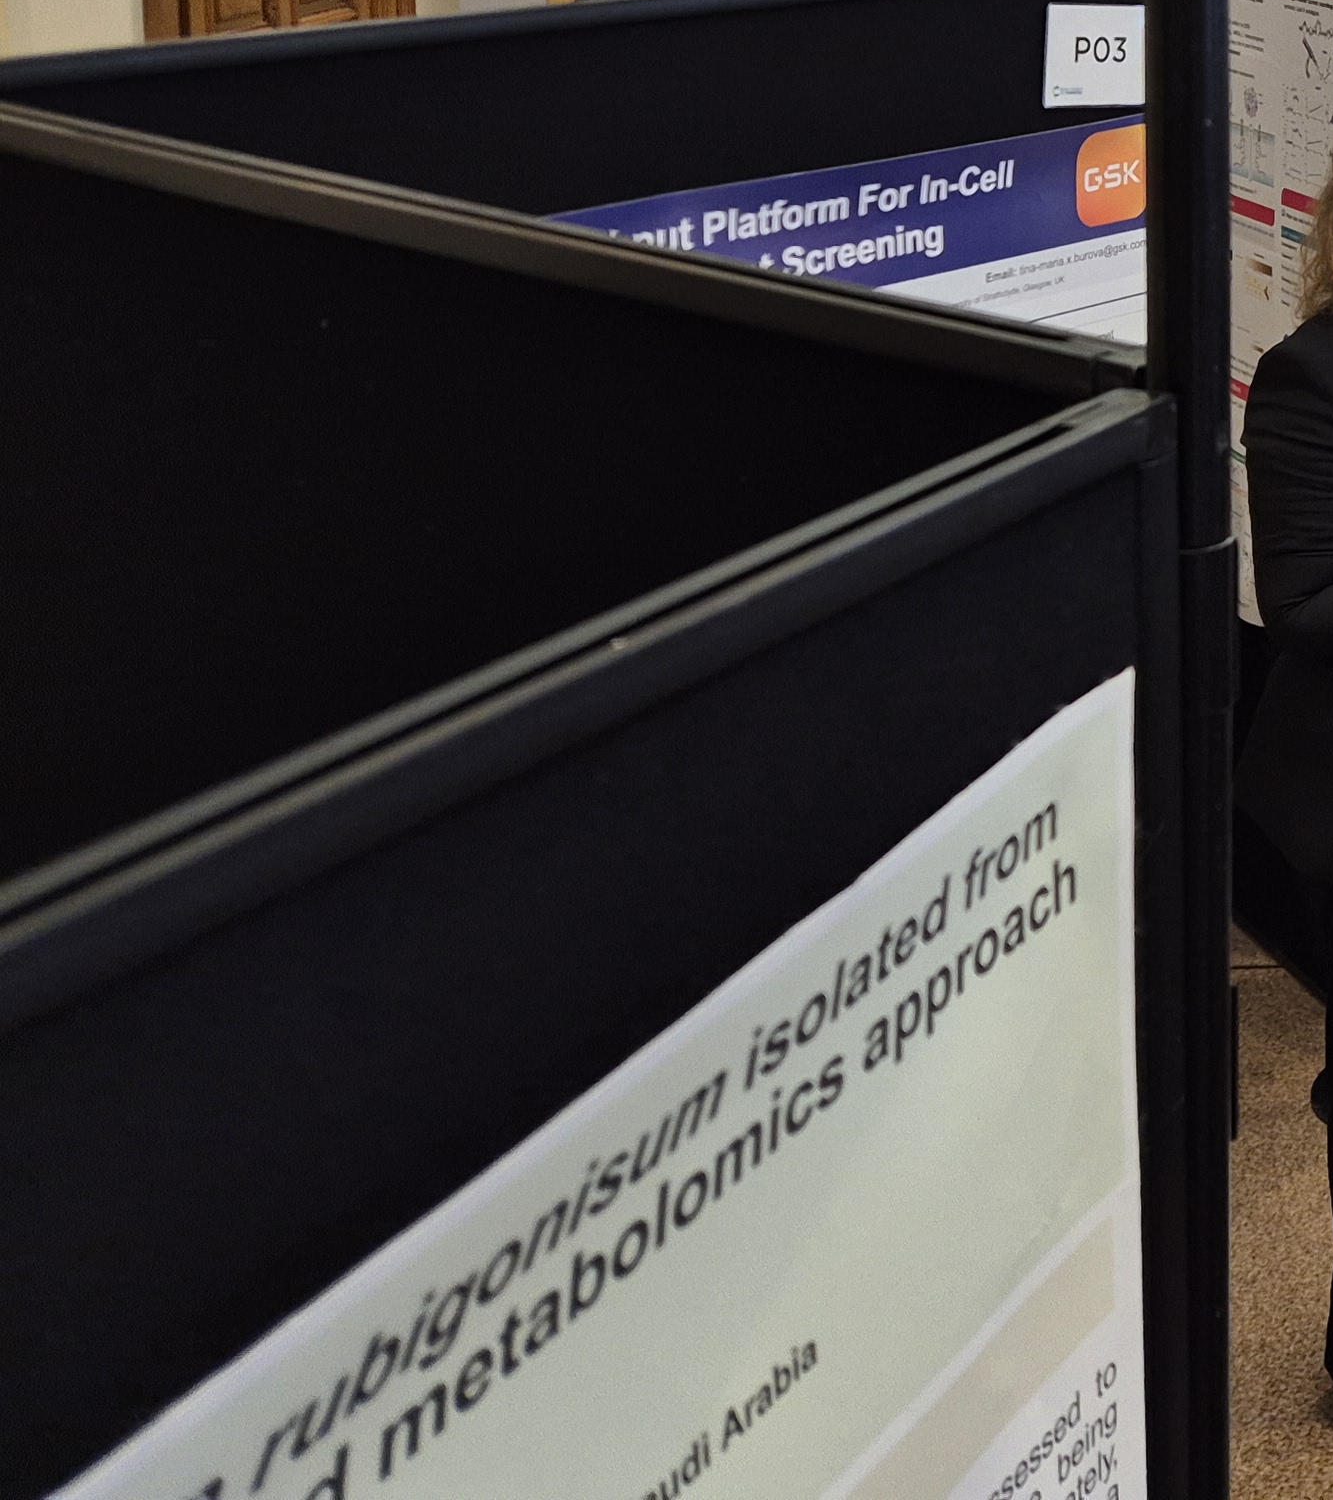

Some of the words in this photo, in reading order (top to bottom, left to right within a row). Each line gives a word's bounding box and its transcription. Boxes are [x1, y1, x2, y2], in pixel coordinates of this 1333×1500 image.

[1074, 36, 1128, 64] P03
[702, 196, 850, 247] Platform
[857, 182, 915, 217] For
[919, 159, 1015, 205] In-Cell
[1084, 159, 1141, 193] GSK
[781, 225, 945, 277] Screening
[742, 874, 952, 1091] isolated
[963, 802, 1059, 912] from
[378, 1054, 845, 1483] metabolomics
[862, 859, 1079, 1065] approach
[251, 1070, 727, 1493] rubigonisum
[720, 1340, 819, 1452] Arabia
[1095, 1362, 1118, 1398] to
[1057, 1401, 1118, 1485] being
